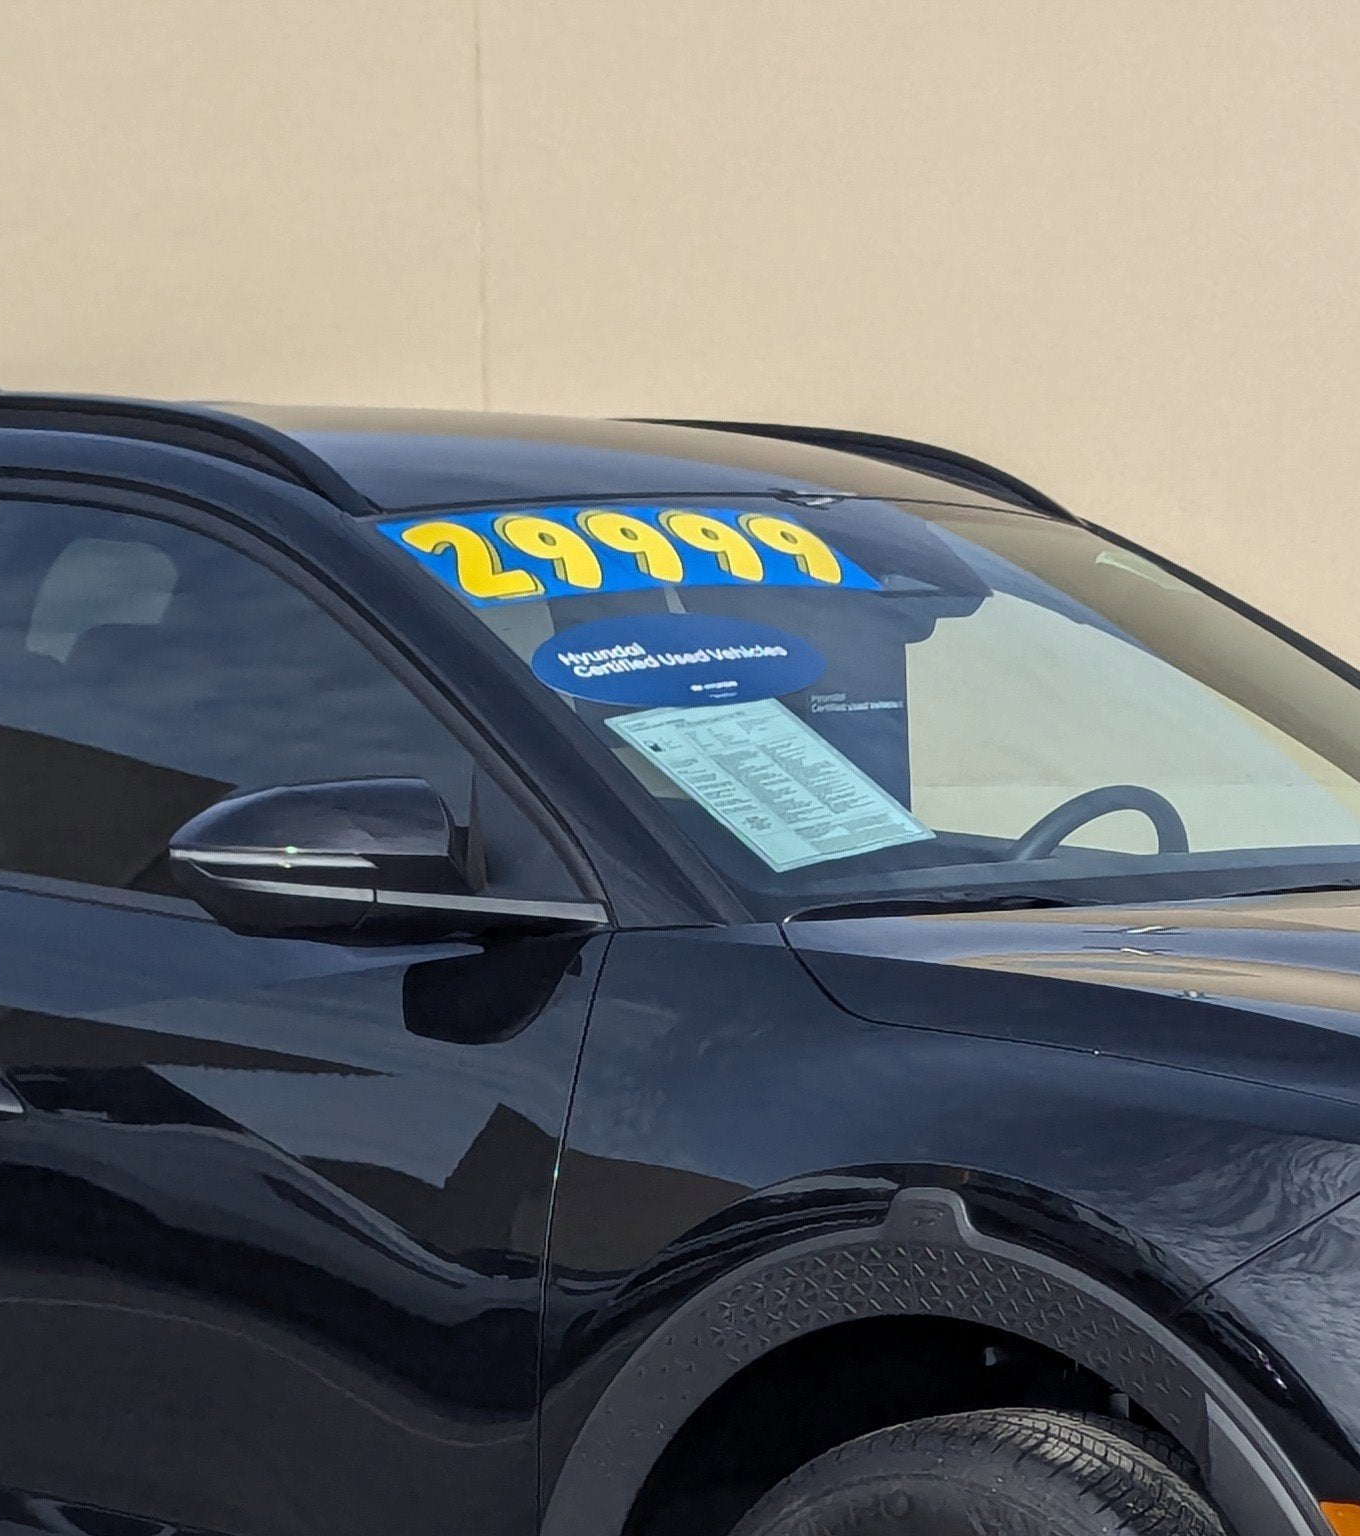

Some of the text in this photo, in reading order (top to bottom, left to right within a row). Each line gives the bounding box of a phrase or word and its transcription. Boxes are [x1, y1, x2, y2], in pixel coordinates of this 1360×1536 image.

[401, 507, 843, 600] 29999
[558, 642, 646, 667] Hyundai
[574, 644, 788, 678] Certified Used Vehicles
